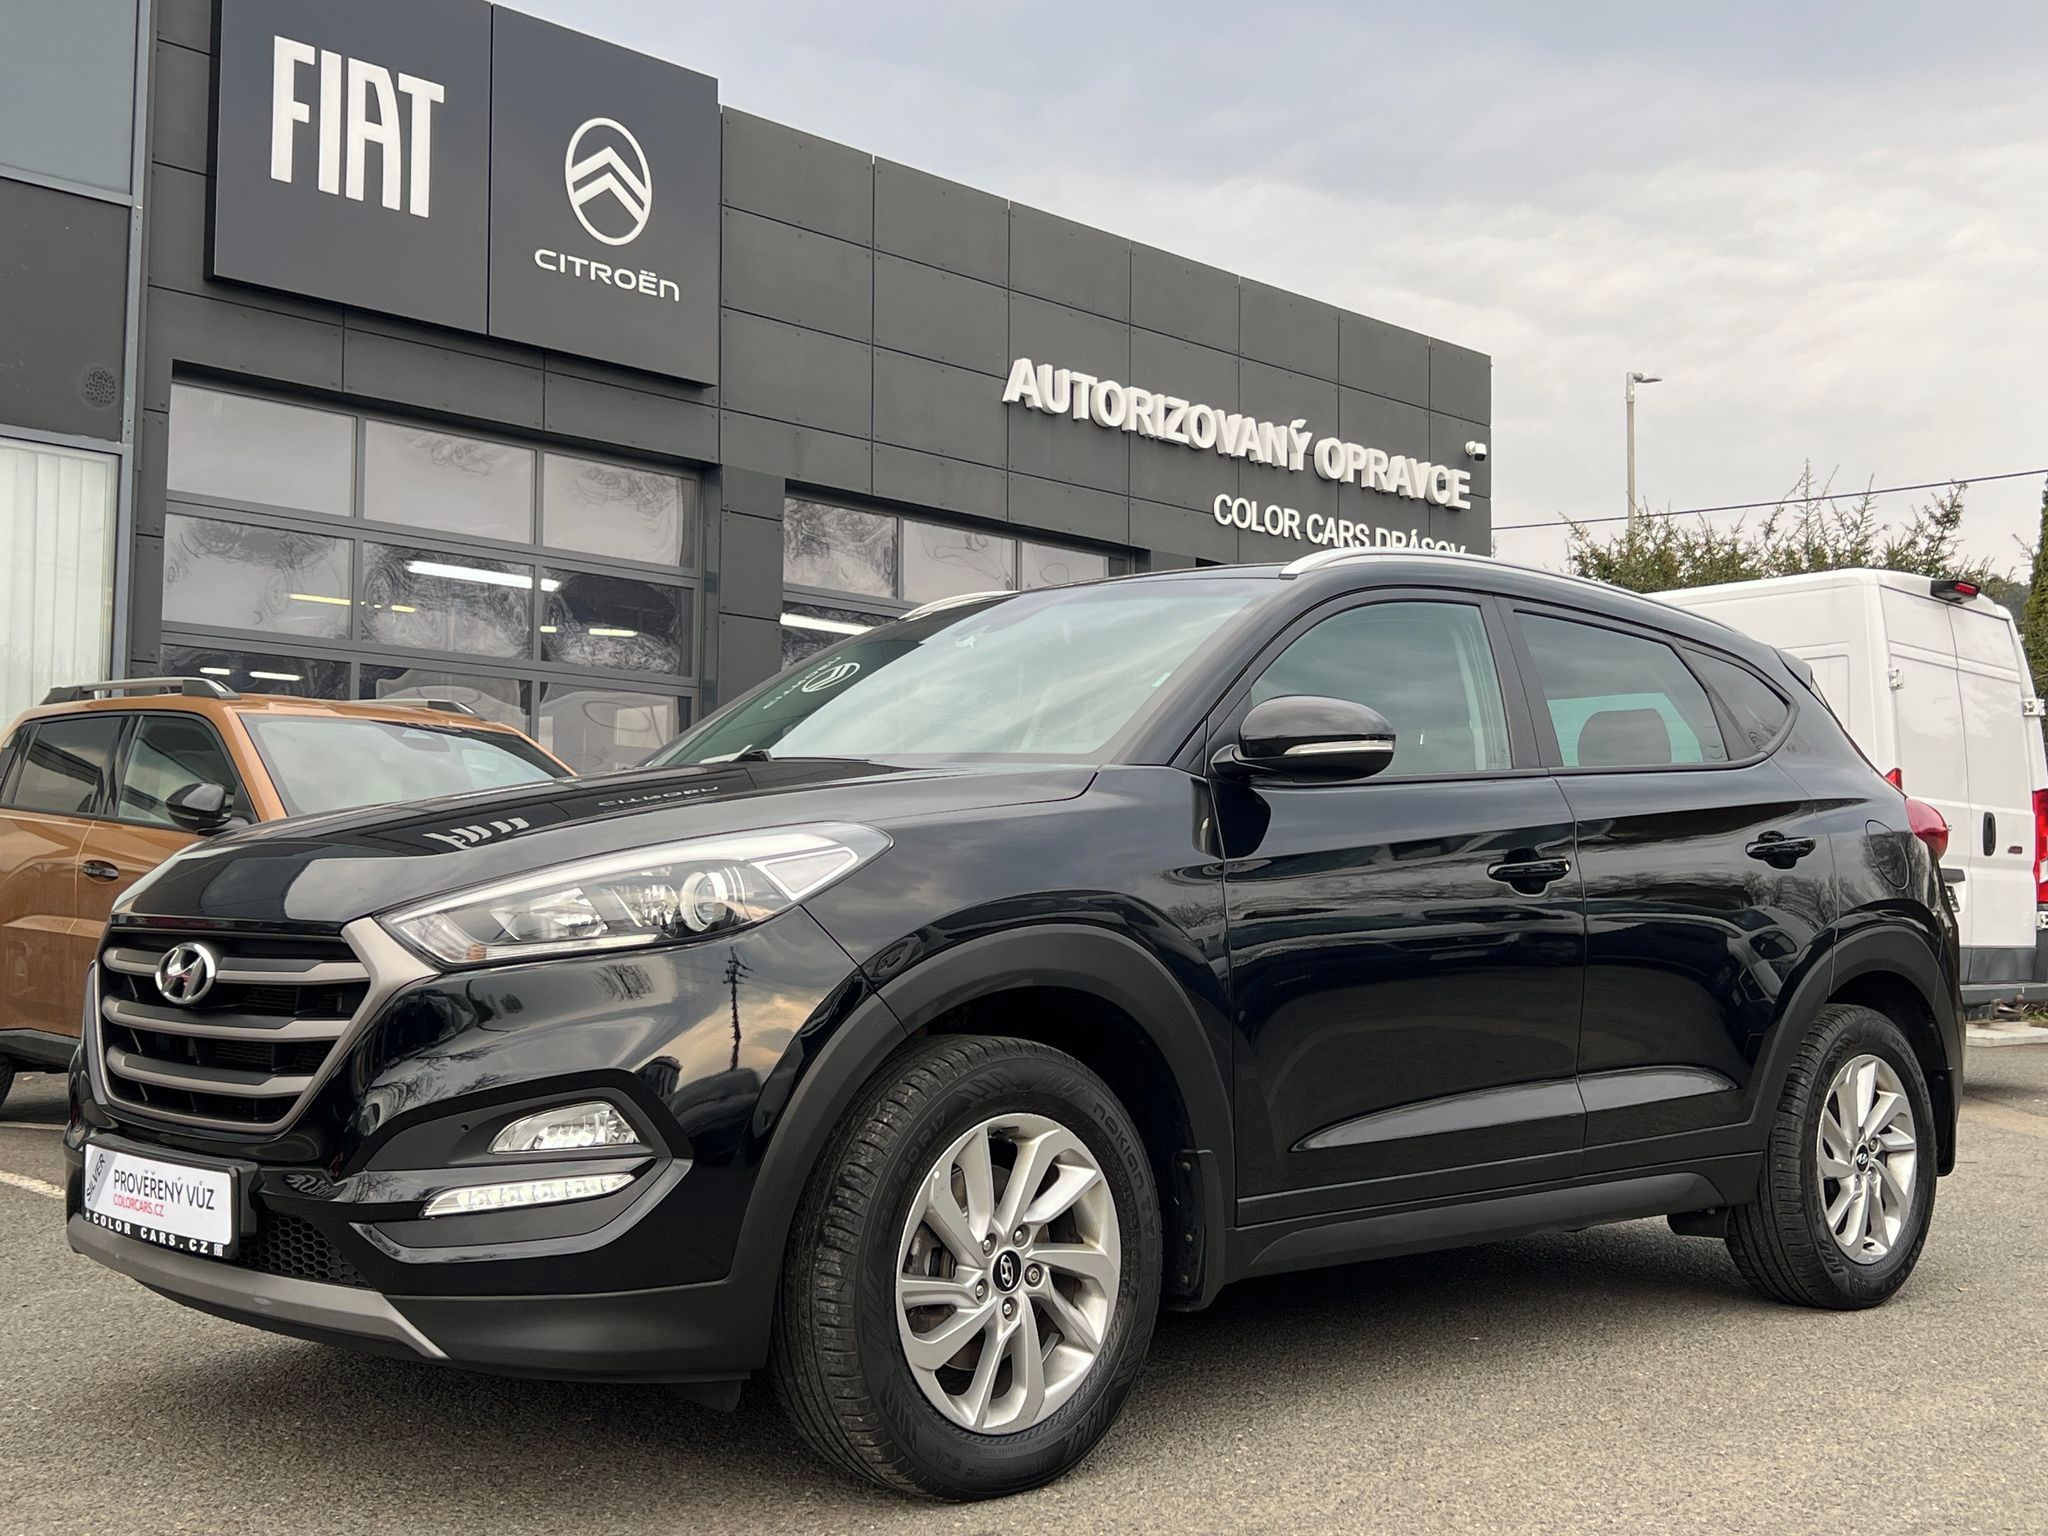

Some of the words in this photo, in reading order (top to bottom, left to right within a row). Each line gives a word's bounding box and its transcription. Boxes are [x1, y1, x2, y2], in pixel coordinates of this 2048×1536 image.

[271, 35, 445, 219] FIAT
[1002, 357, 1312, 472] AUTORIZOVANÝ
[1313, 436, 1472, 511] OPRAVCE
[1213, 494, 1301, 541] COLOR
[1306, 513, 1371, 548] CARS
[86, 1153, 106, 1202] SILVER
[113, 1169, 184, 1205] PROVĚŘENÝ
[186, 1180, 215, 1210] VŮZ
[92, 1213, 132, 1235] COLOR
[113, 1193, 165, 1218] COLORCARS.CZ
